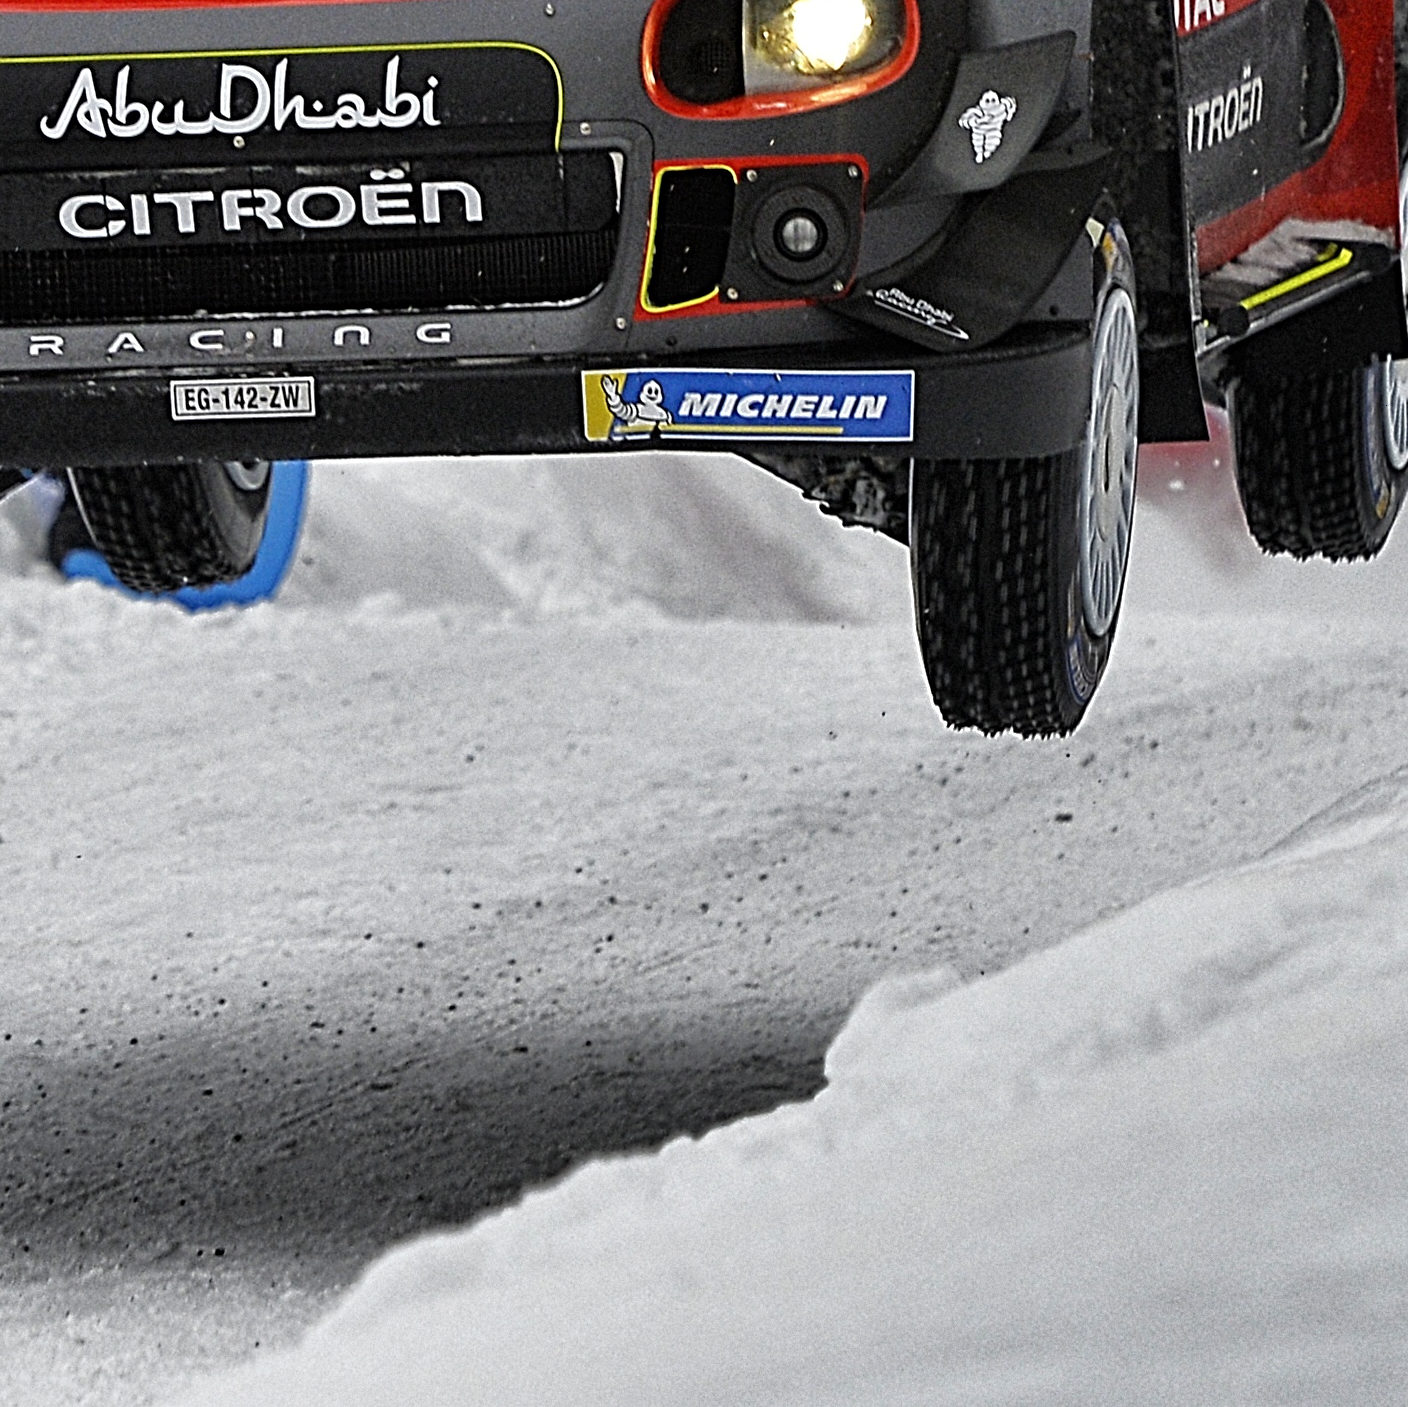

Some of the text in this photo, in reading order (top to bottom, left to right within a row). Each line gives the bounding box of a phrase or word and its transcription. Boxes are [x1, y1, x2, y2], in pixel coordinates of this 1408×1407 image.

[39, 54, 441, 141] Abu Dhabi
[1187, 64, 1263, 154] ITROËN
[58, 167, 484, 239] CITROËN
[28, 322, 453, 358] RACING
[183, 383, 302, 412] EG-142-ZW
[678, 392, 888, 420] MICHELIN
